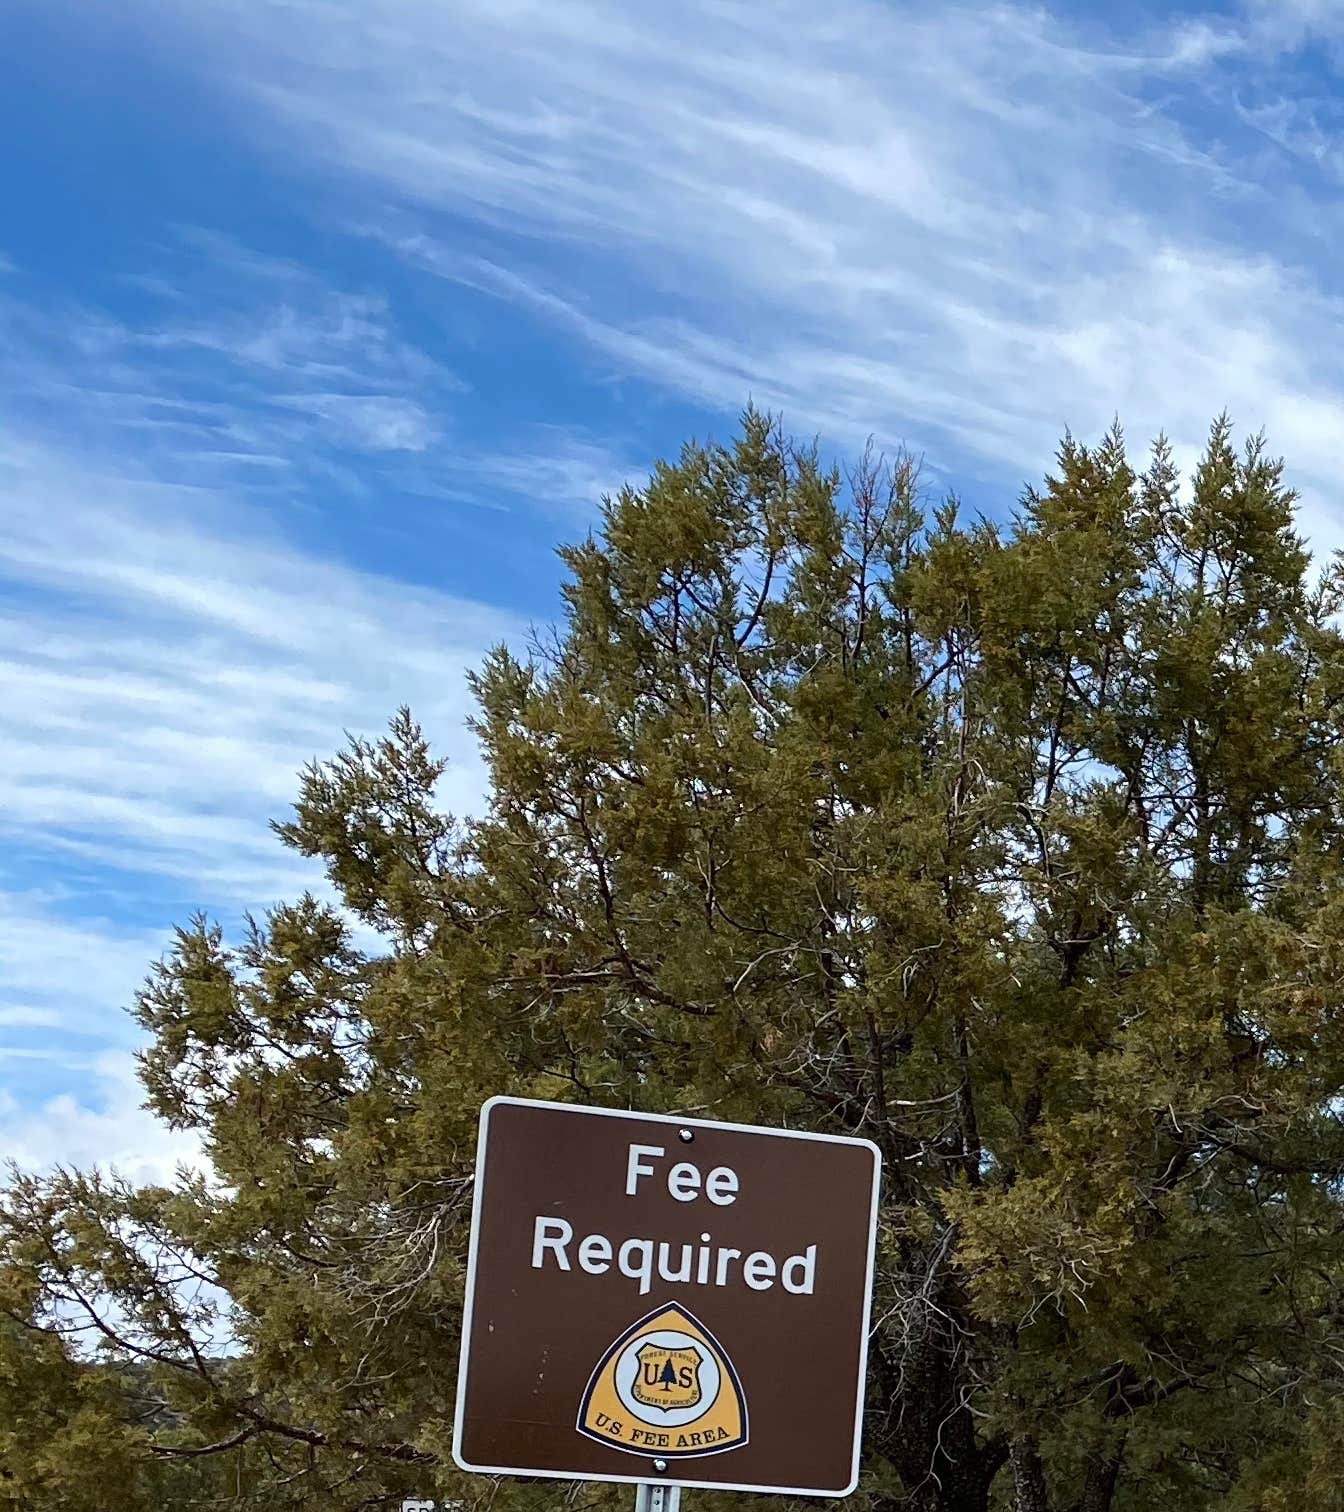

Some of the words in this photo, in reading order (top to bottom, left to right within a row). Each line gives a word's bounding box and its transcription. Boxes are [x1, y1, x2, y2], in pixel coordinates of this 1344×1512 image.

[625, 1144, 739, 1206] Fee
[531, 1216, 817, 1295] Required
[595, 1412, 623, 1437] U.S.
[630, 1428, 669, 1447] FEE
[676, 1426, 731, 1448] AREA
